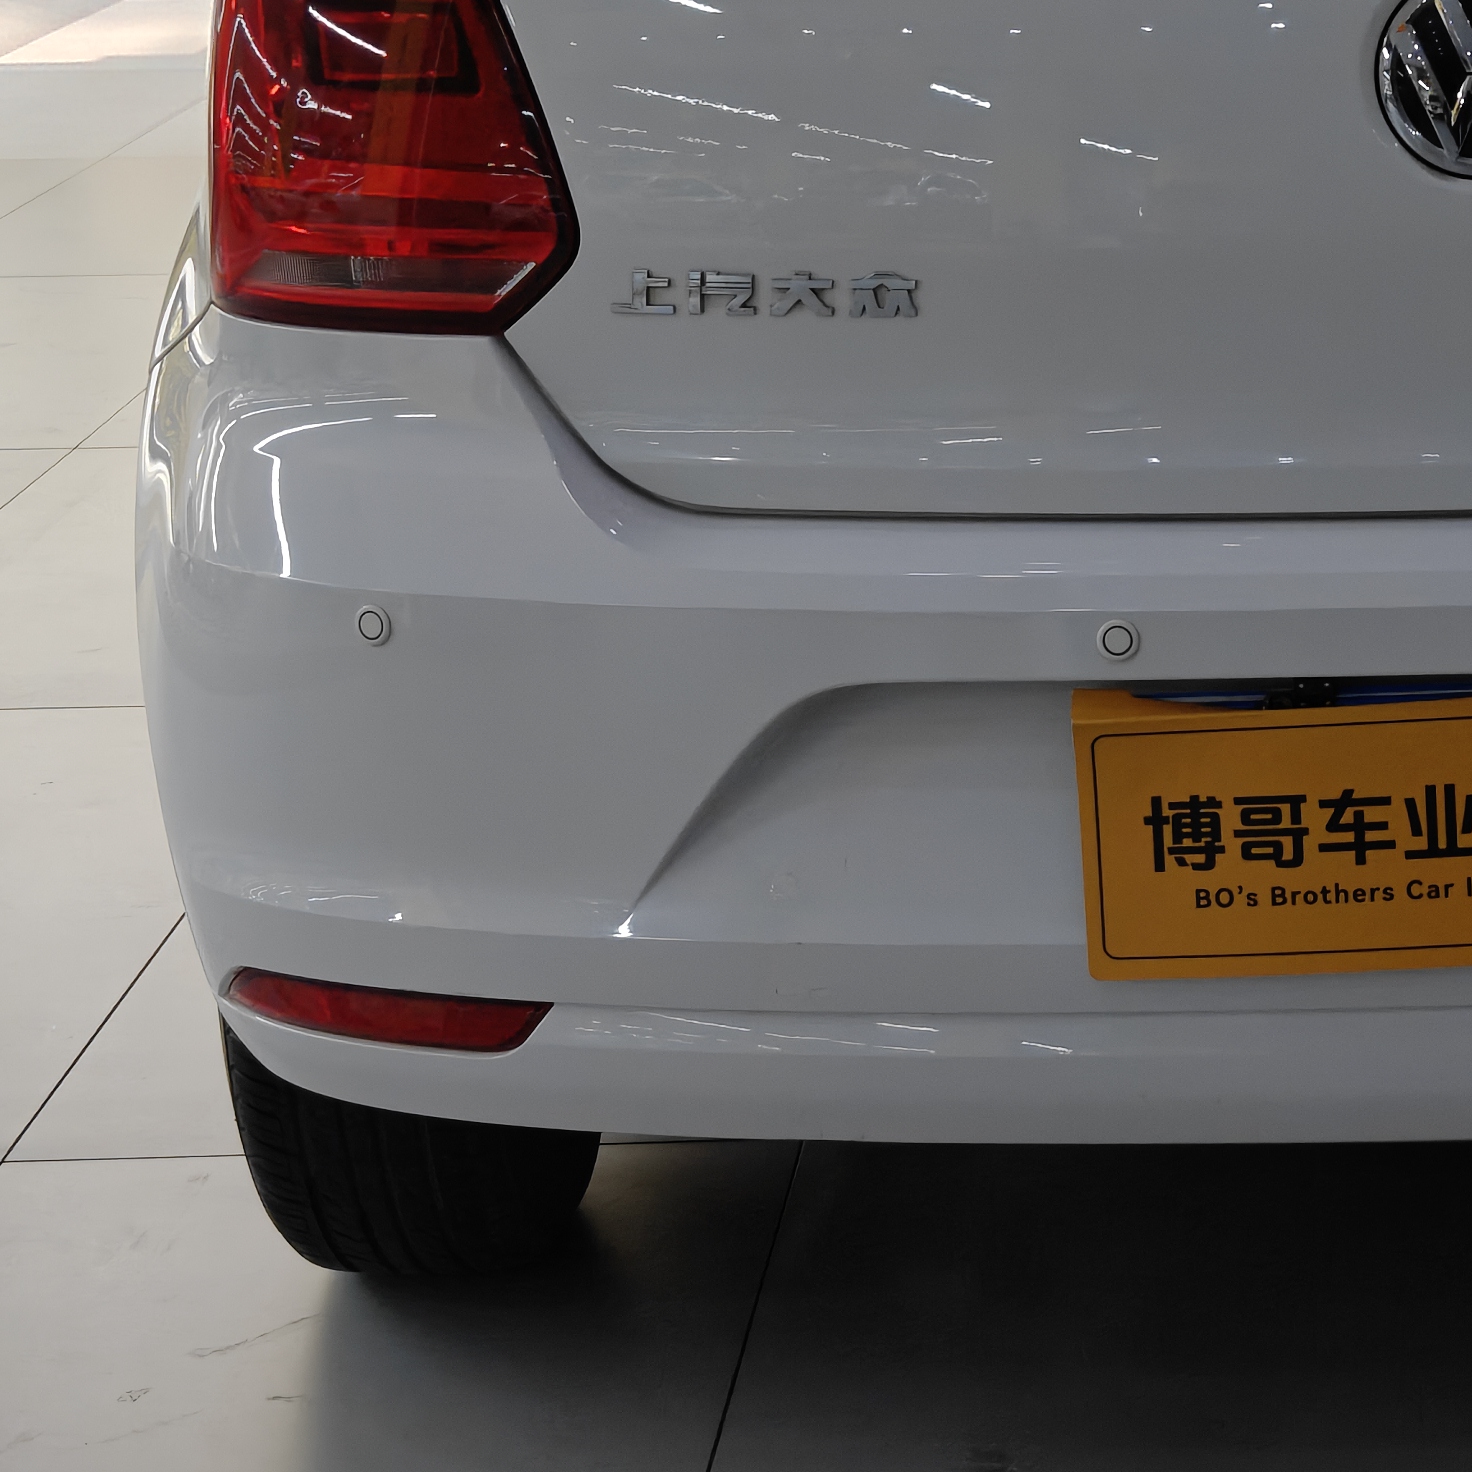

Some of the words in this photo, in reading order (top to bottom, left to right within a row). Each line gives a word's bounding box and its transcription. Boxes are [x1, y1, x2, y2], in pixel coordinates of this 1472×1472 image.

[610, 268, 918, 319] 上汽大众
[1194, 885, 1259, 910] BO's
[1270, 877, 1395, 907] Brothers
[1406, 877, 1455, 902] Car
